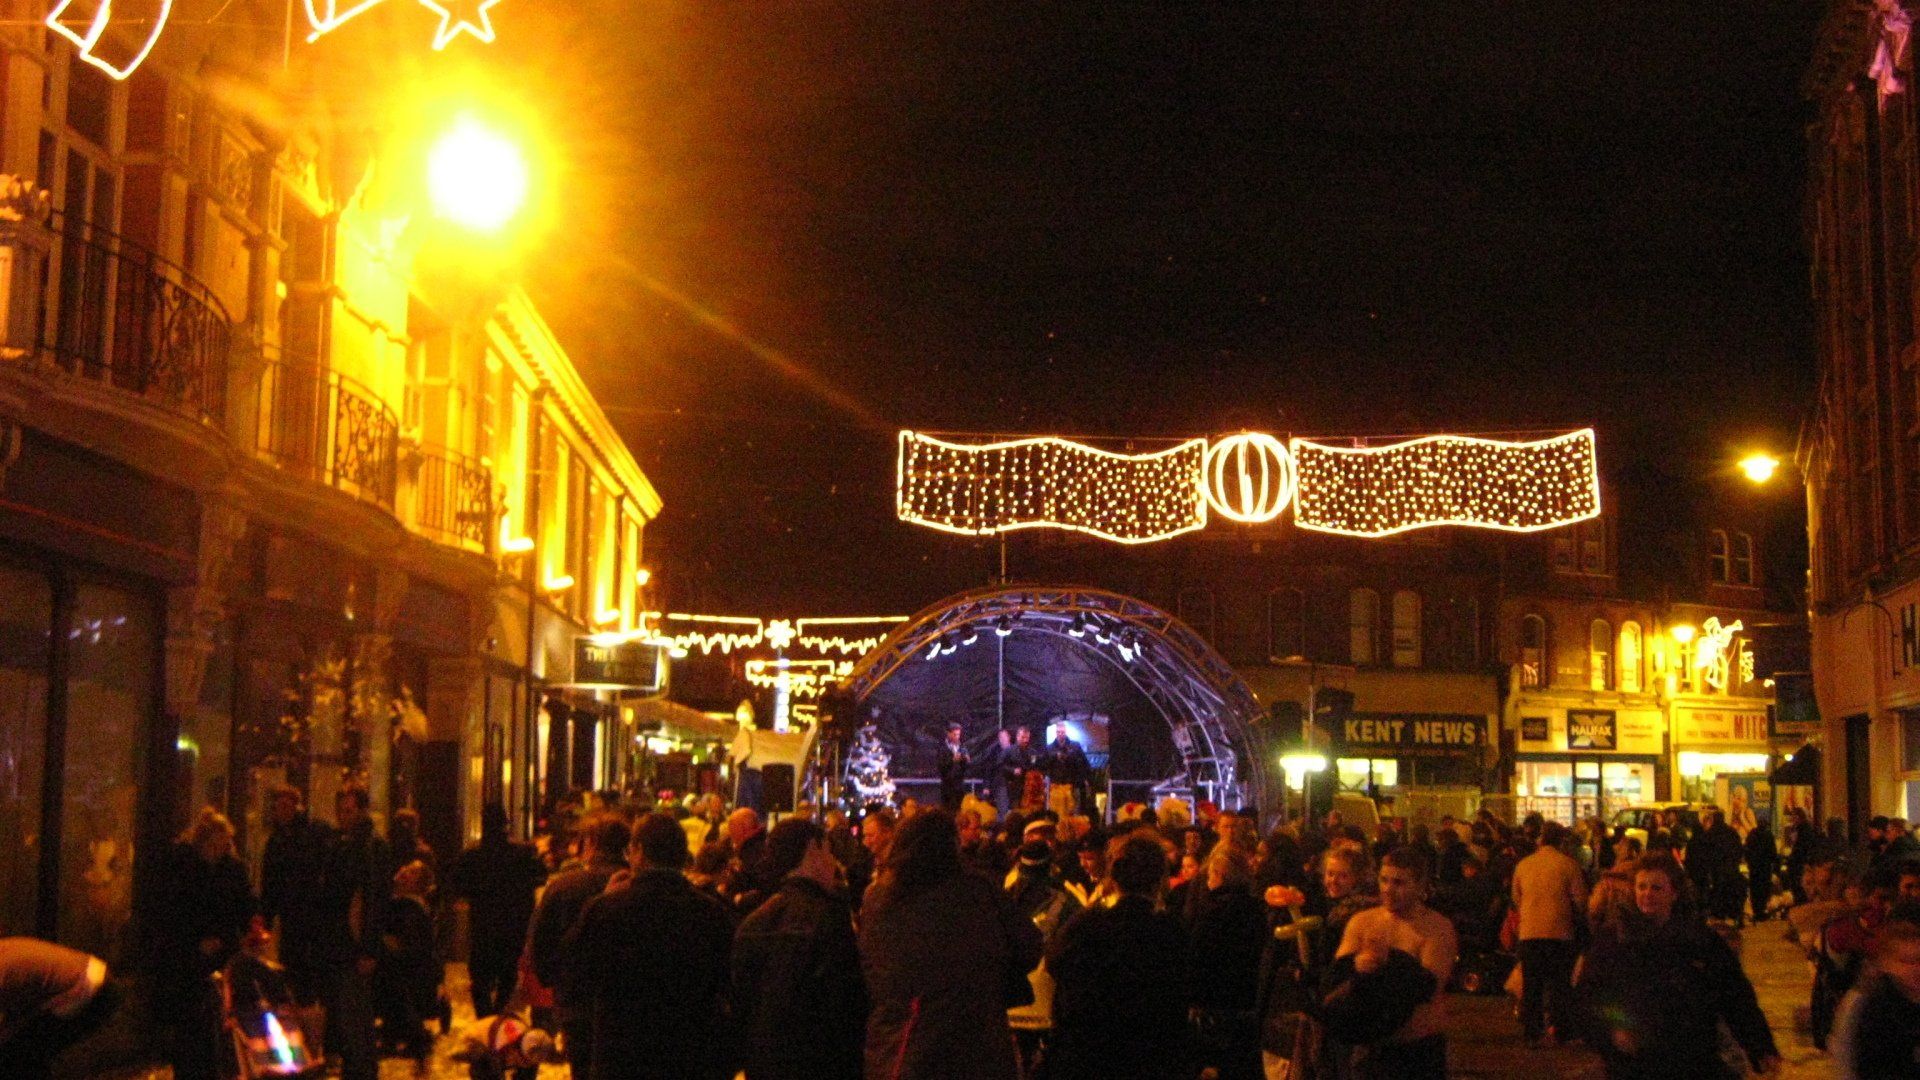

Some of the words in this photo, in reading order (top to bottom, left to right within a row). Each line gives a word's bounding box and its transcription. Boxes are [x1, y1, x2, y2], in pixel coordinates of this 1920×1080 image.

[1345, 720, 1405, 743] KENT
[1414, 721, 1476, 744] NEWS
[1571, 725, 1612, 736] HALIFAX
